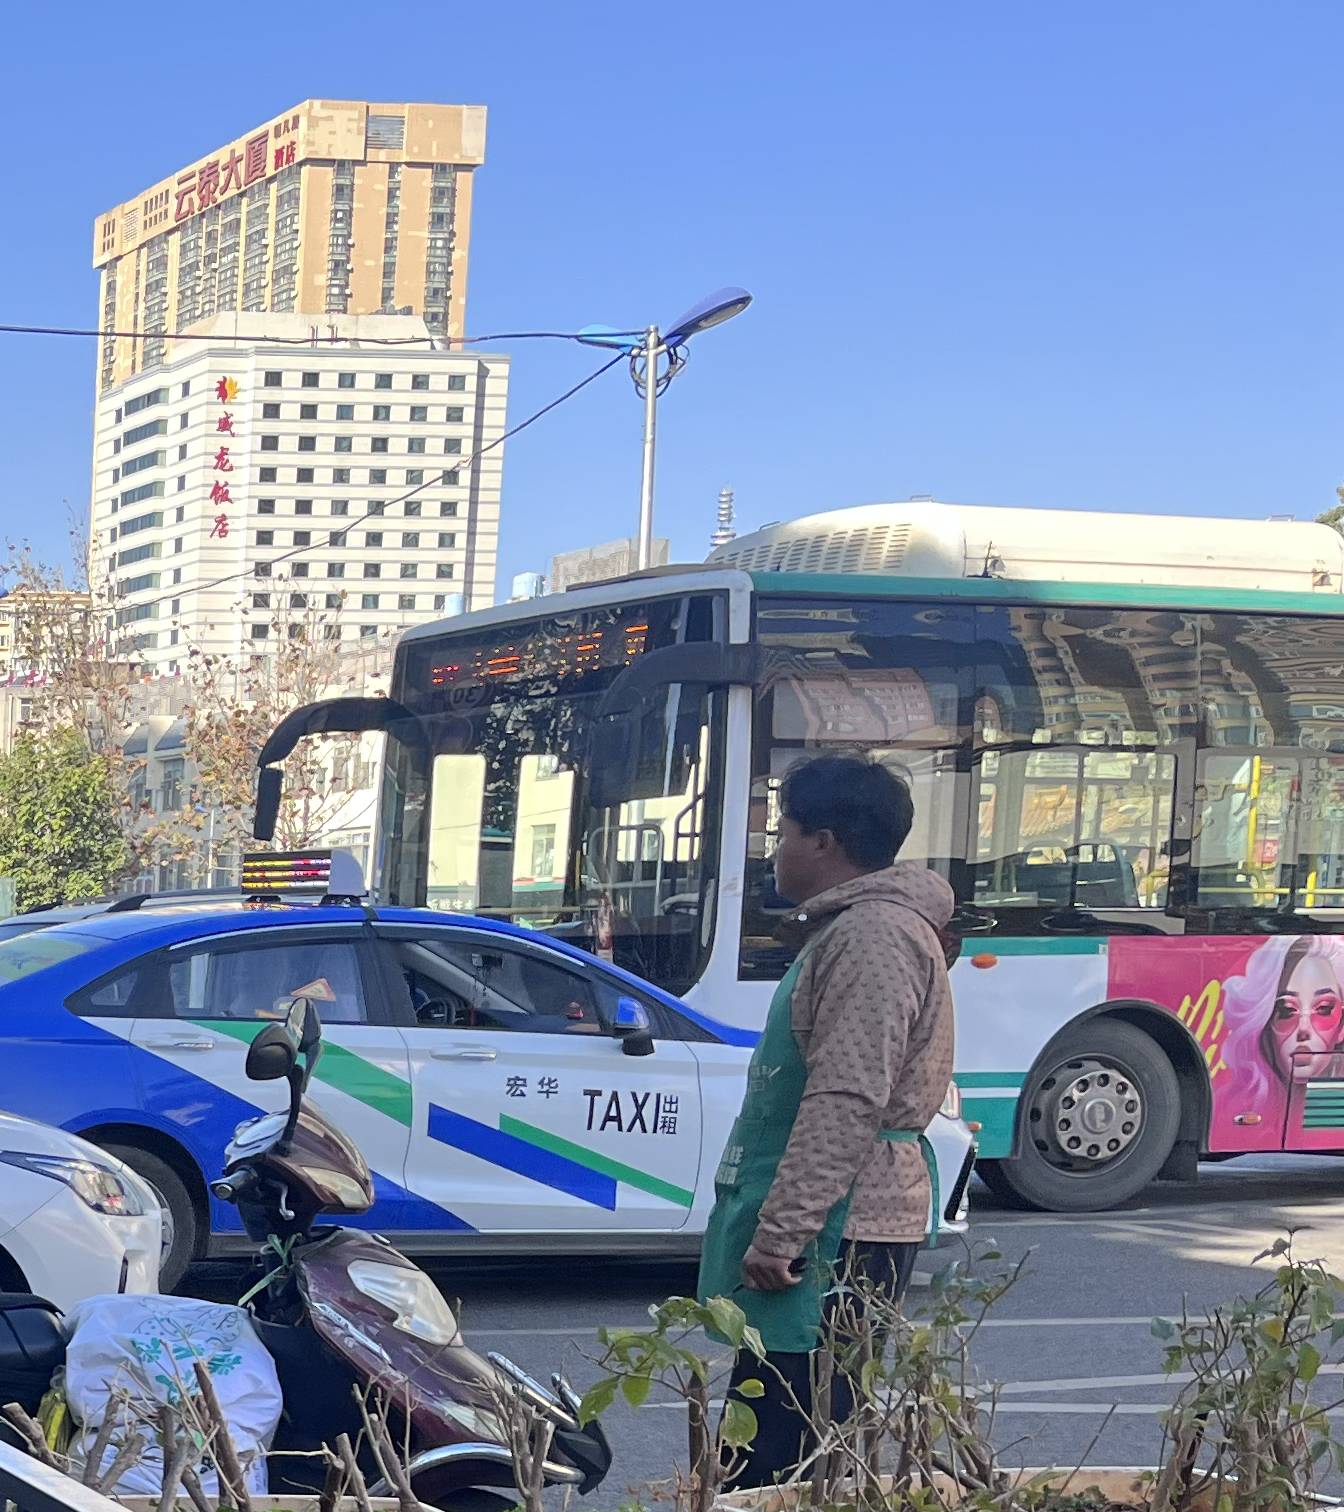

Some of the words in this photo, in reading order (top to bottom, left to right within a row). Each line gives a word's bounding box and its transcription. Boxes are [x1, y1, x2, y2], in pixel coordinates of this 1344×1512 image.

[175, 129, 269, 222] 云泰大厦
[209, 411, 236, 539] 威龙饭店
[506, 1076, 559, 1099] 宏华
[583, 1089, 660, 1134] TAXI
[659, 1094, 679, 1135] 出租
